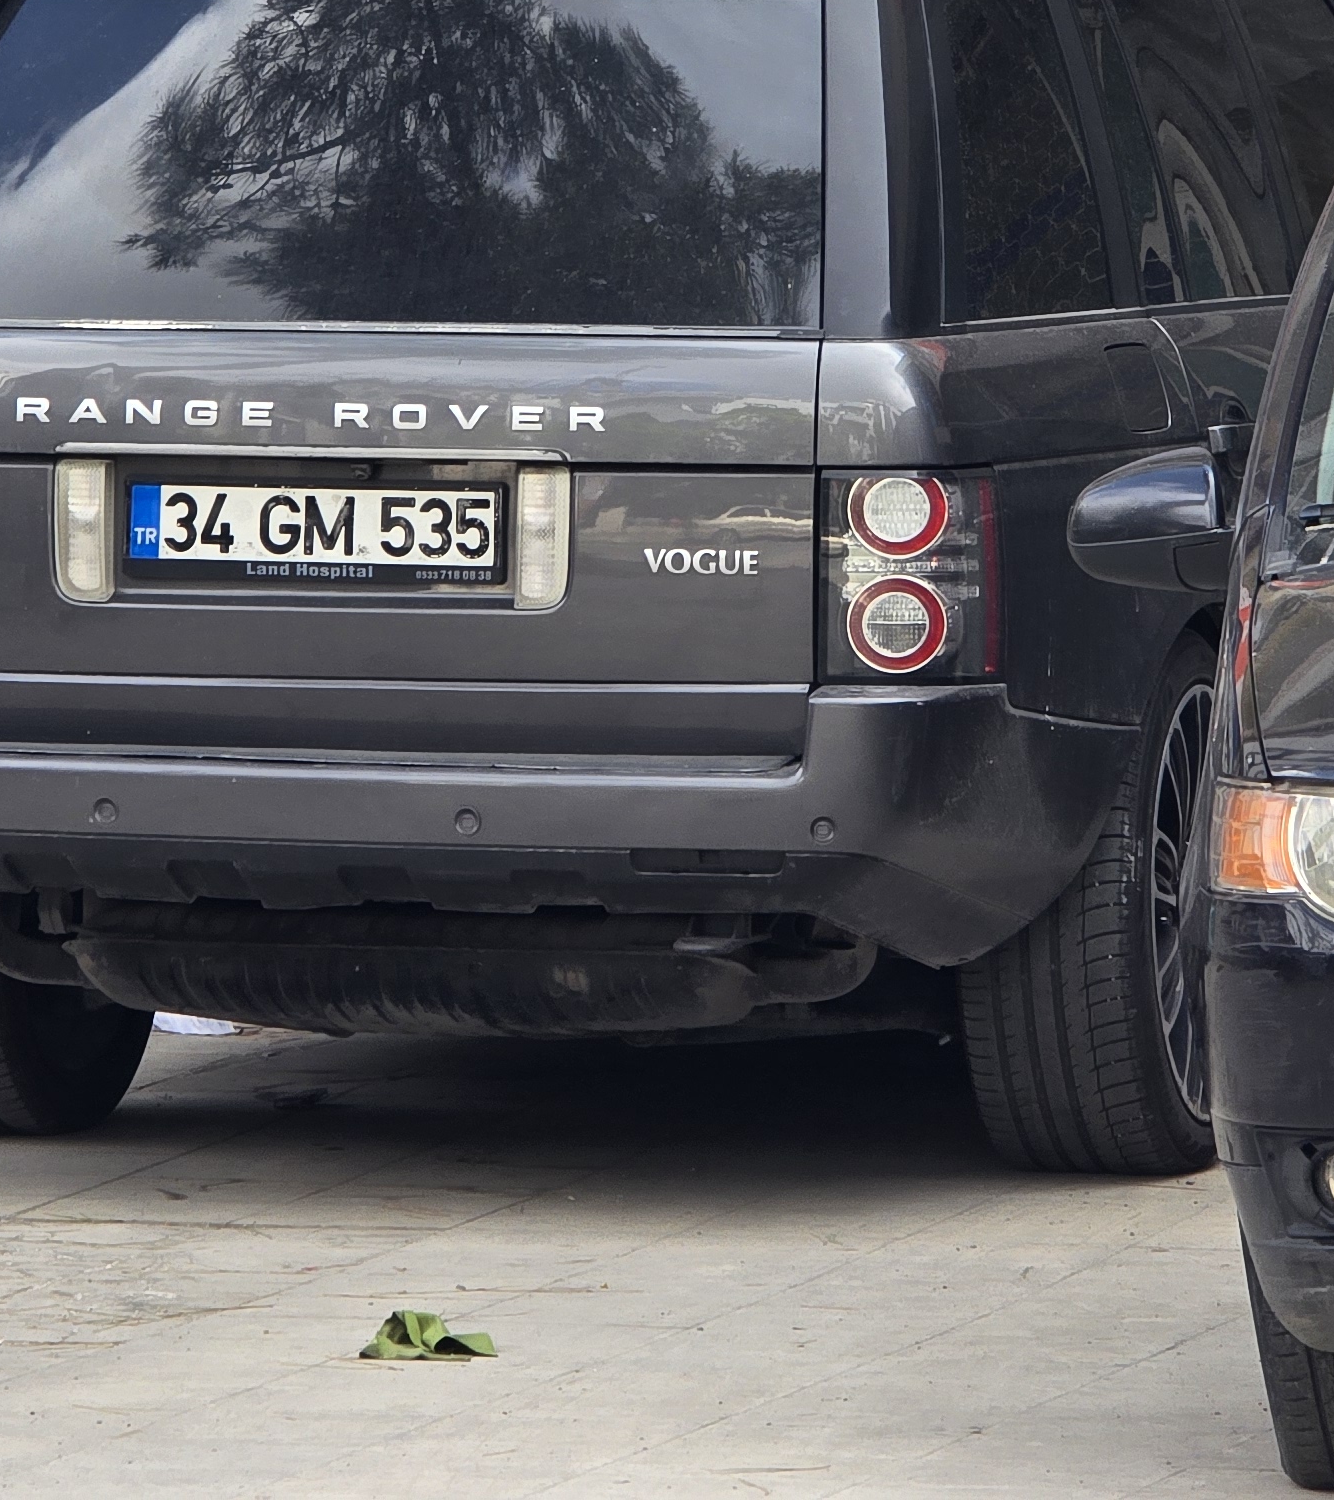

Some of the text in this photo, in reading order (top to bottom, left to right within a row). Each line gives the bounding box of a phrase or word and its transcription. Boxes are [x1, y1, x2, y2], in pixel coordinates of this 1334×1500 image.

[16, 396, 606, 433] RANGE ROVER
[134, 527, 158, 545] TR
[164, 492, 491, 559] 34 GM 535
[246, 562, 374, 579] Land Hospital
[643, 548, 759, 575] VOGUE
